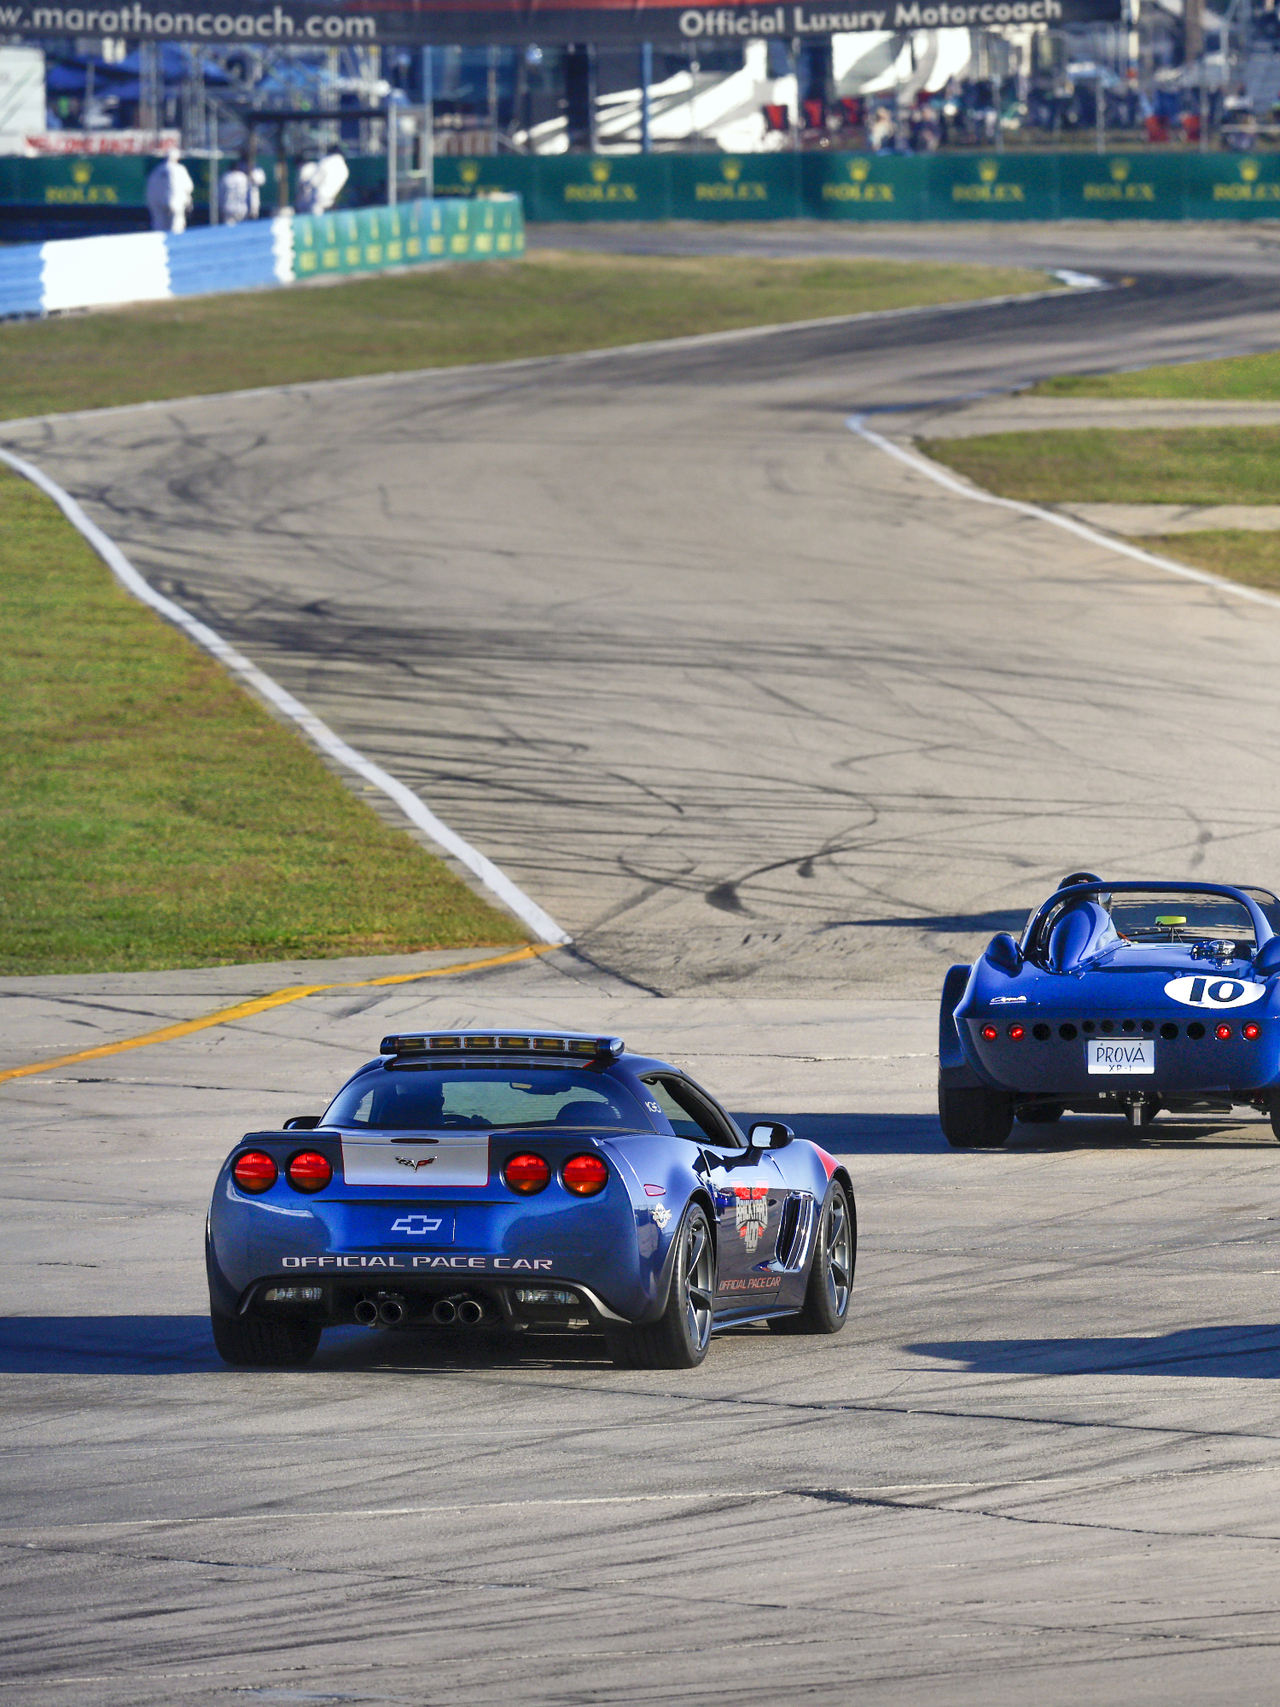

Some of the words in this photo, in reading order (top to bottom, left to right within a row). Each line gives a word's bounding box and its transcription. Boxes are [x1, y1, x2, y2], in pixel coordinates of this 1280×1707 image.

[679, 9, 785, 36] Official
[793, 7, 886, 32] Luxury
[895, 0, 1061, 27] Motorcoach
[565, 184, 637, 201] ROLEX
[695, 182, 767, 200] ROLEX
[822, 182, 894, 201] ROLEX
[952, 182, 1025, 201] ROLEX
[1083, 182, 1154, 200] ROLEX
[1189, 977, 1245, 1002] 10
[1096, 1046, 1146, 1063] PROVA
[281, 1256, 405, 1268] OFFICIAL
[412, 1256, 486, 1268] PACE
[493, 1257, 553, 1270] CAR
[719, 1279, 747, 1291] OFFICIAL
[747, 1277, 767, 1289] PACE
[766, 1276, 782, 1287] CAR
